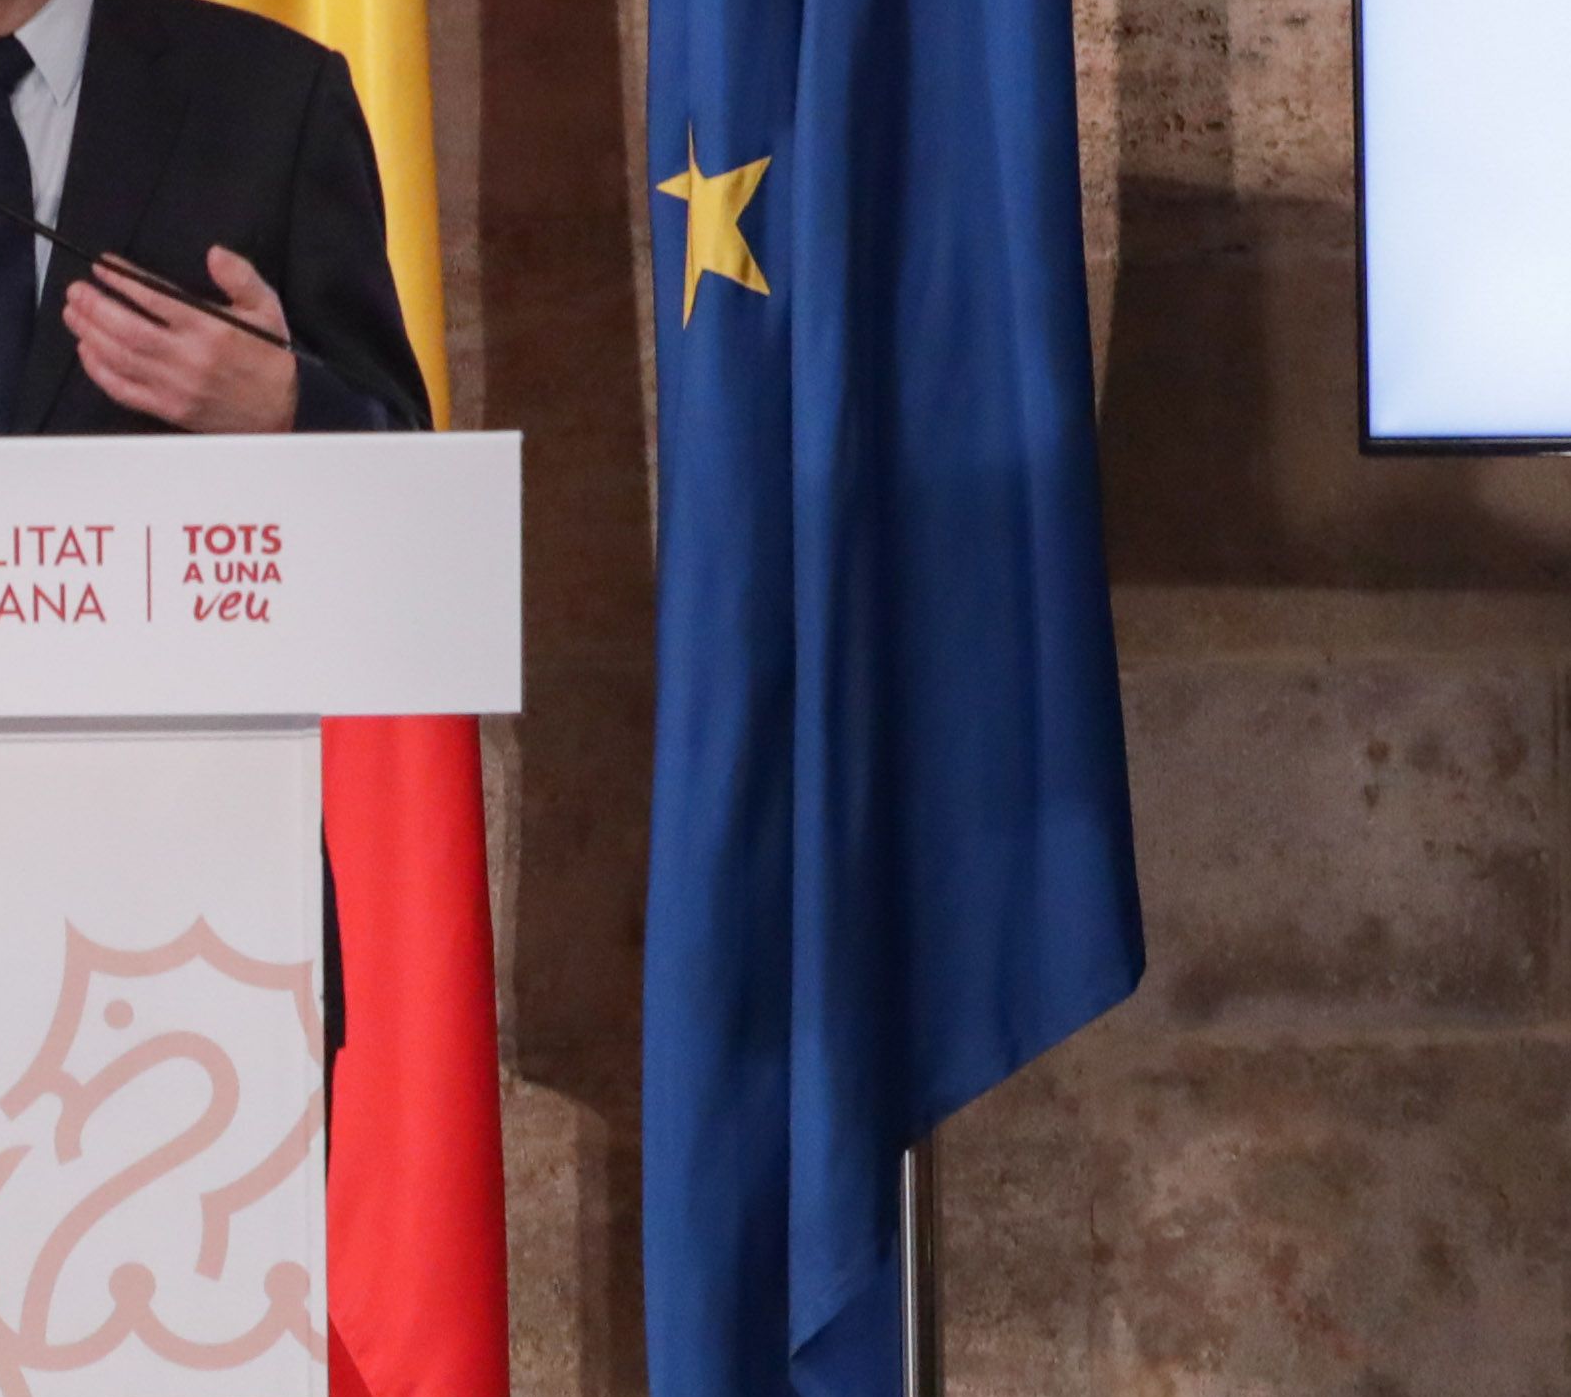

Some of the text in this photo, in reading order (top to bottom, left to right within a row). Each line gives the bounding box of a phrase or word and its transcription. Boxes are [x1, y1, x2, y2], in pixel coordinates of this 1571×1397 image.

[183, 525, 281, 555] TOTS
[184, 562, 281, 583] A UNA
[194, 591, 268, 622] veu
